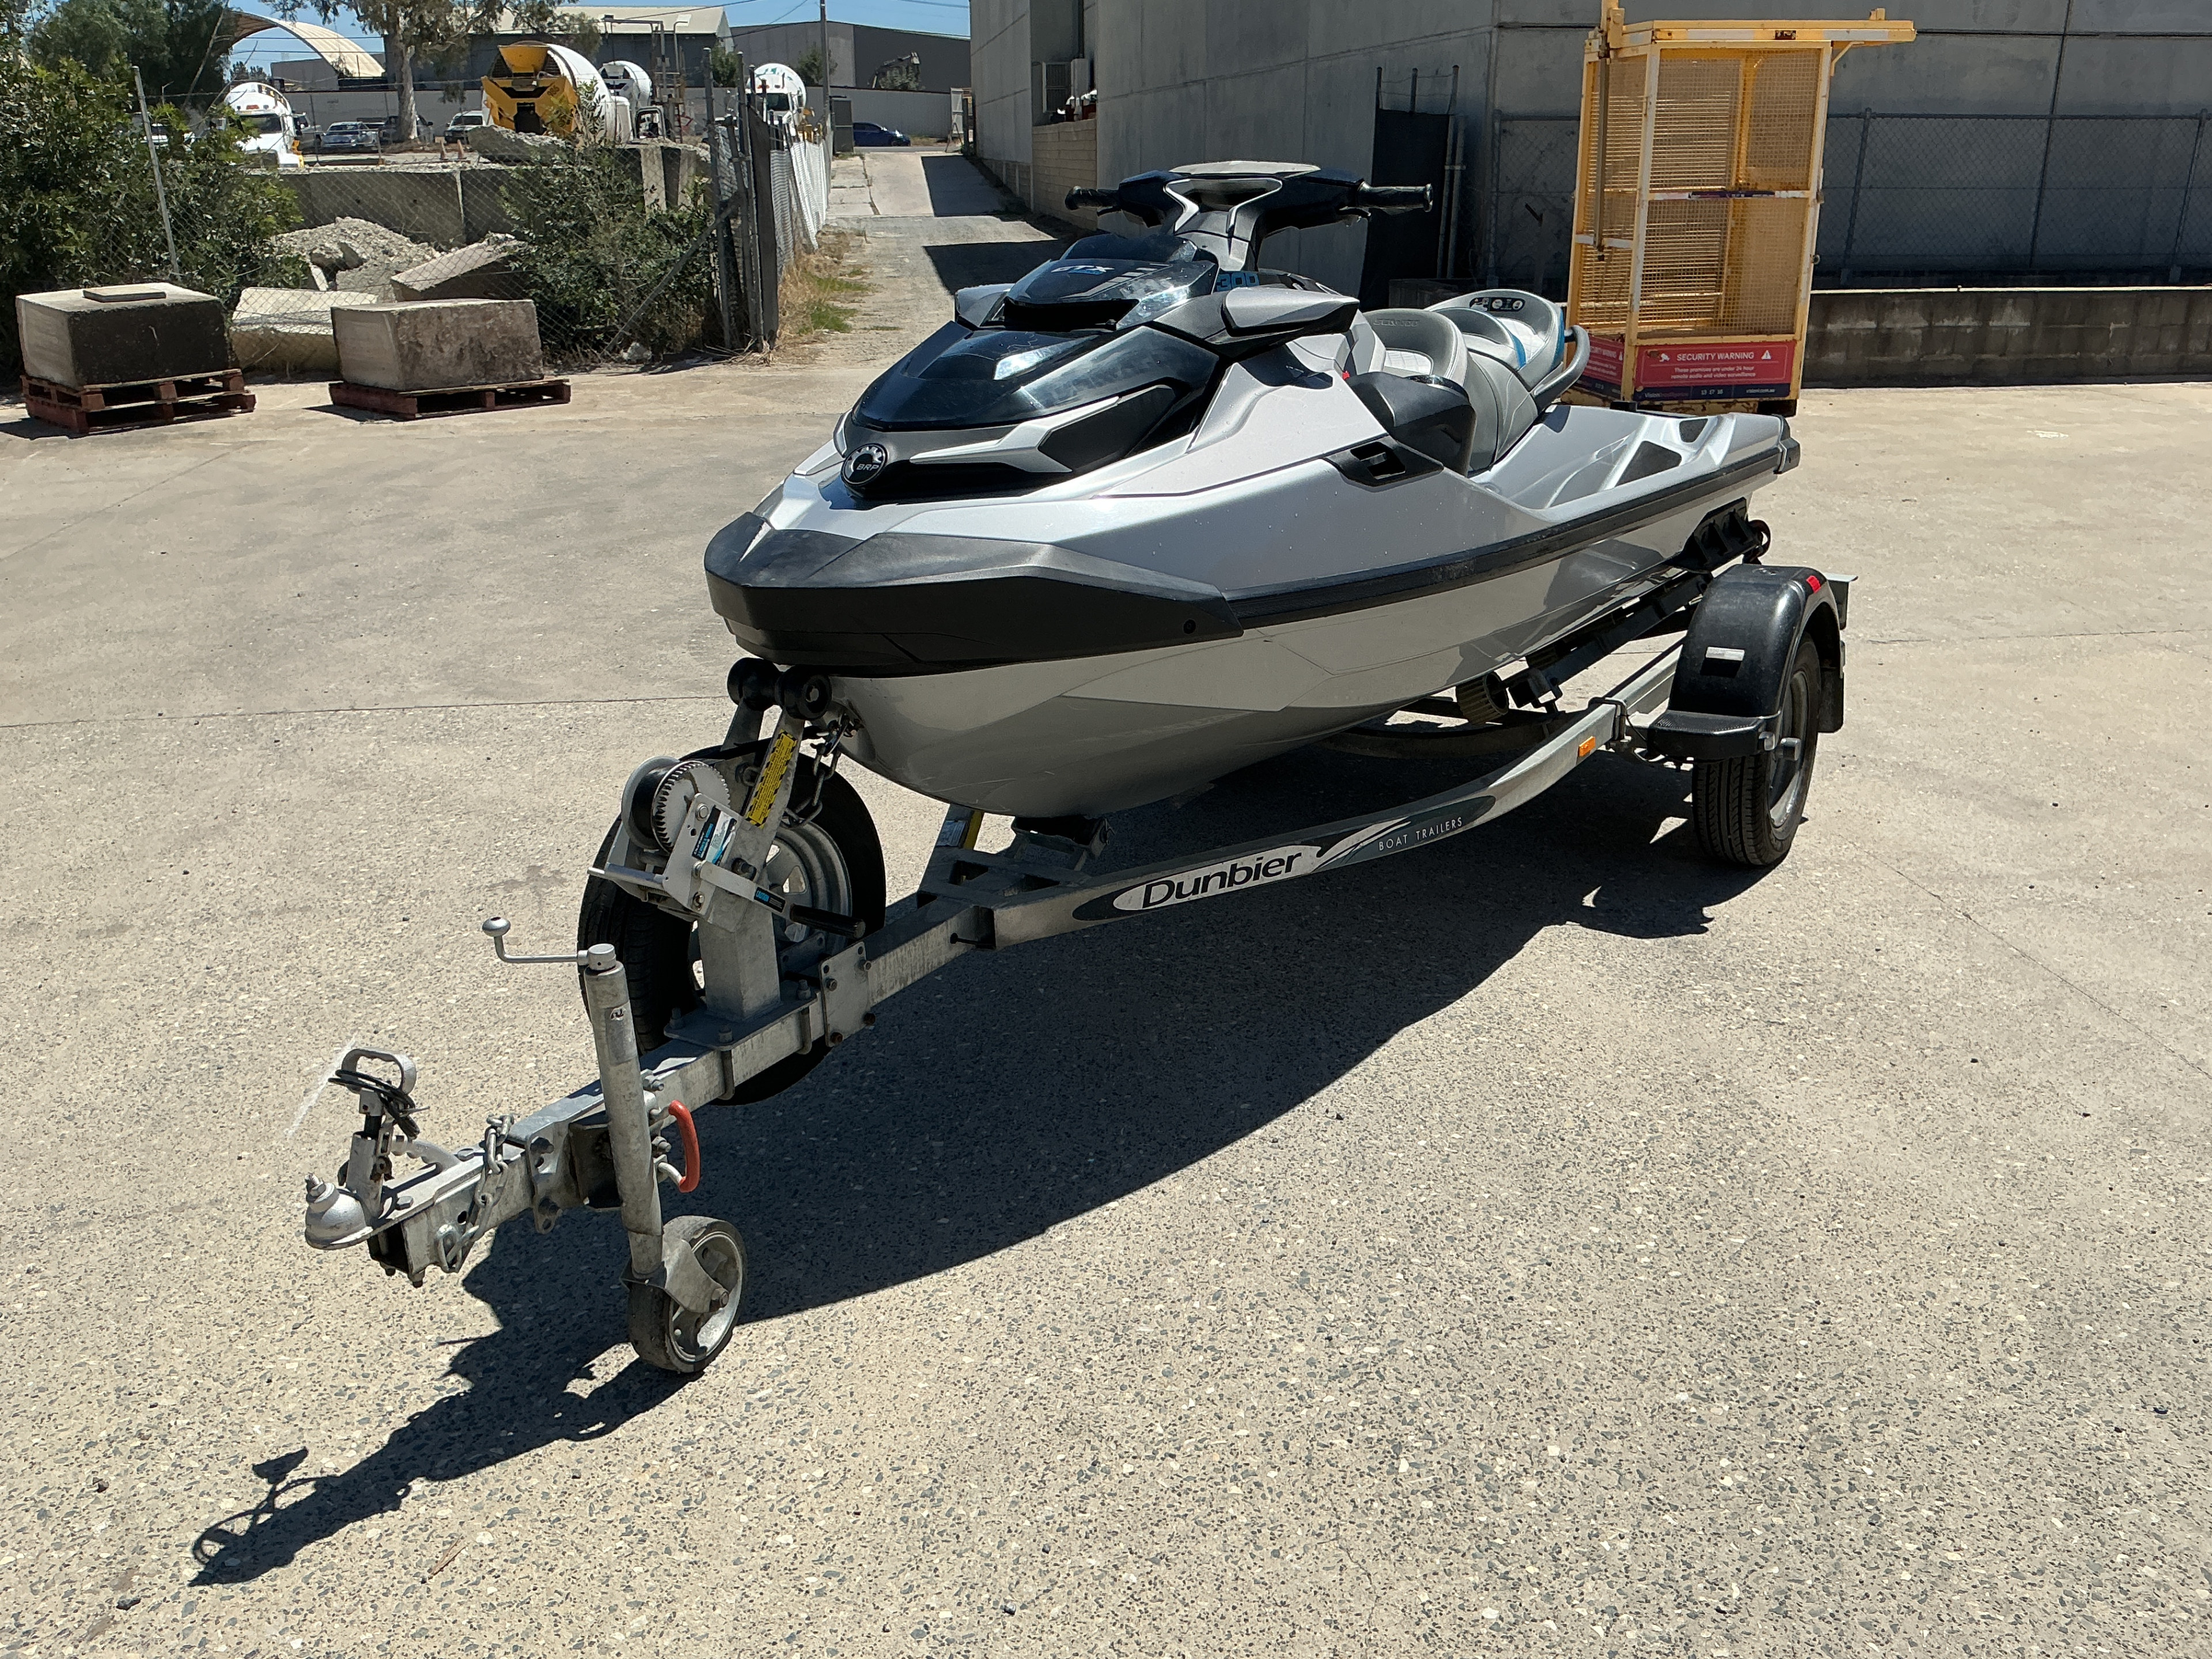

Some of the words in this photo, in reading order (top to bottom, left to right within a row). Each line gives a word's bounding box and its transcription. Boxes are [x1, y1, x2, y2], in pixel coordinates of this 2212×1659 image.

[1217, 272, 1260, 291] 300
[1677, 353, 1716, 361] SECURITY
[1717, 352, 1755, 360] WARNING
[1378, 834, 1408, 851] BOAT
[1416, 817, 1462, 840] TRAILERS
[1142, 853, 1302, 908] Dunbier
